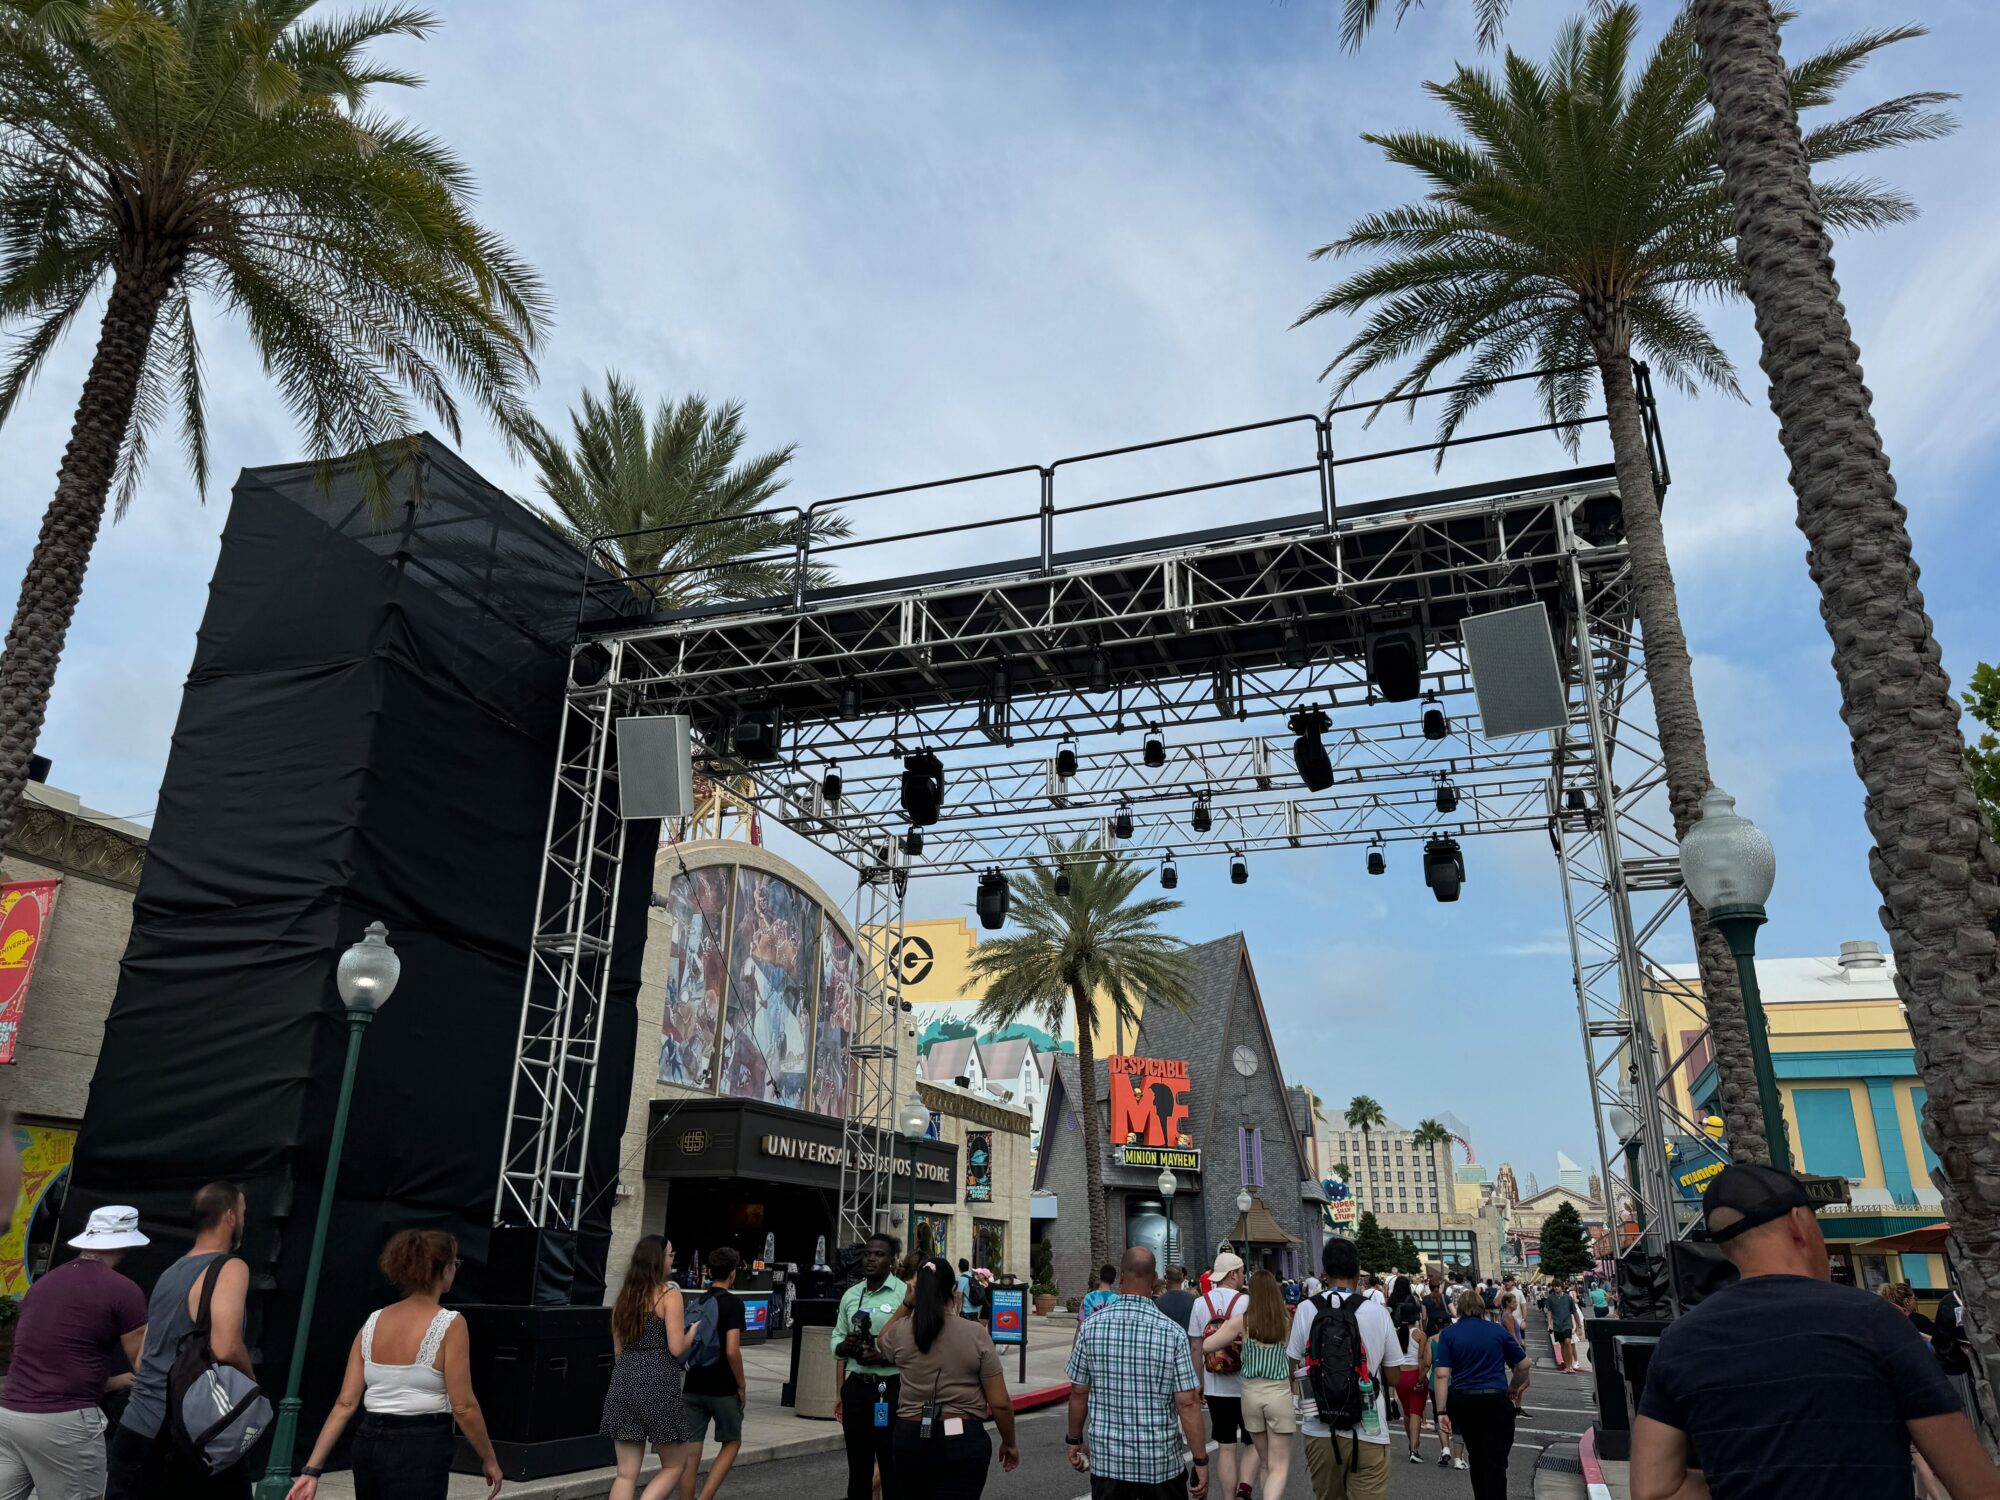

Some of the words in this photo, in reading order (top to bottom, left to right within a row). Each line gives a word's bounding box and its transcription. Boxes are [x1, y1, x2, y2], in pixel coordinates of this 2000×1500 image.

[1113, 1056, 1189, 1078] DESPICABLE
[1110, 1074, 1194, 1148] ME
[767, 1134, 852, 1167] UNIVERSAL
[916, 1162, 950, 1183] STORE
[1125, 1150, 1157, 1166] MINION
[1160, 1152, 1196, 1168] MAYHEM
[1805, 1182, 1836, 1200] ACKS
[1330, 1200, 1355, 1209] SUPER
